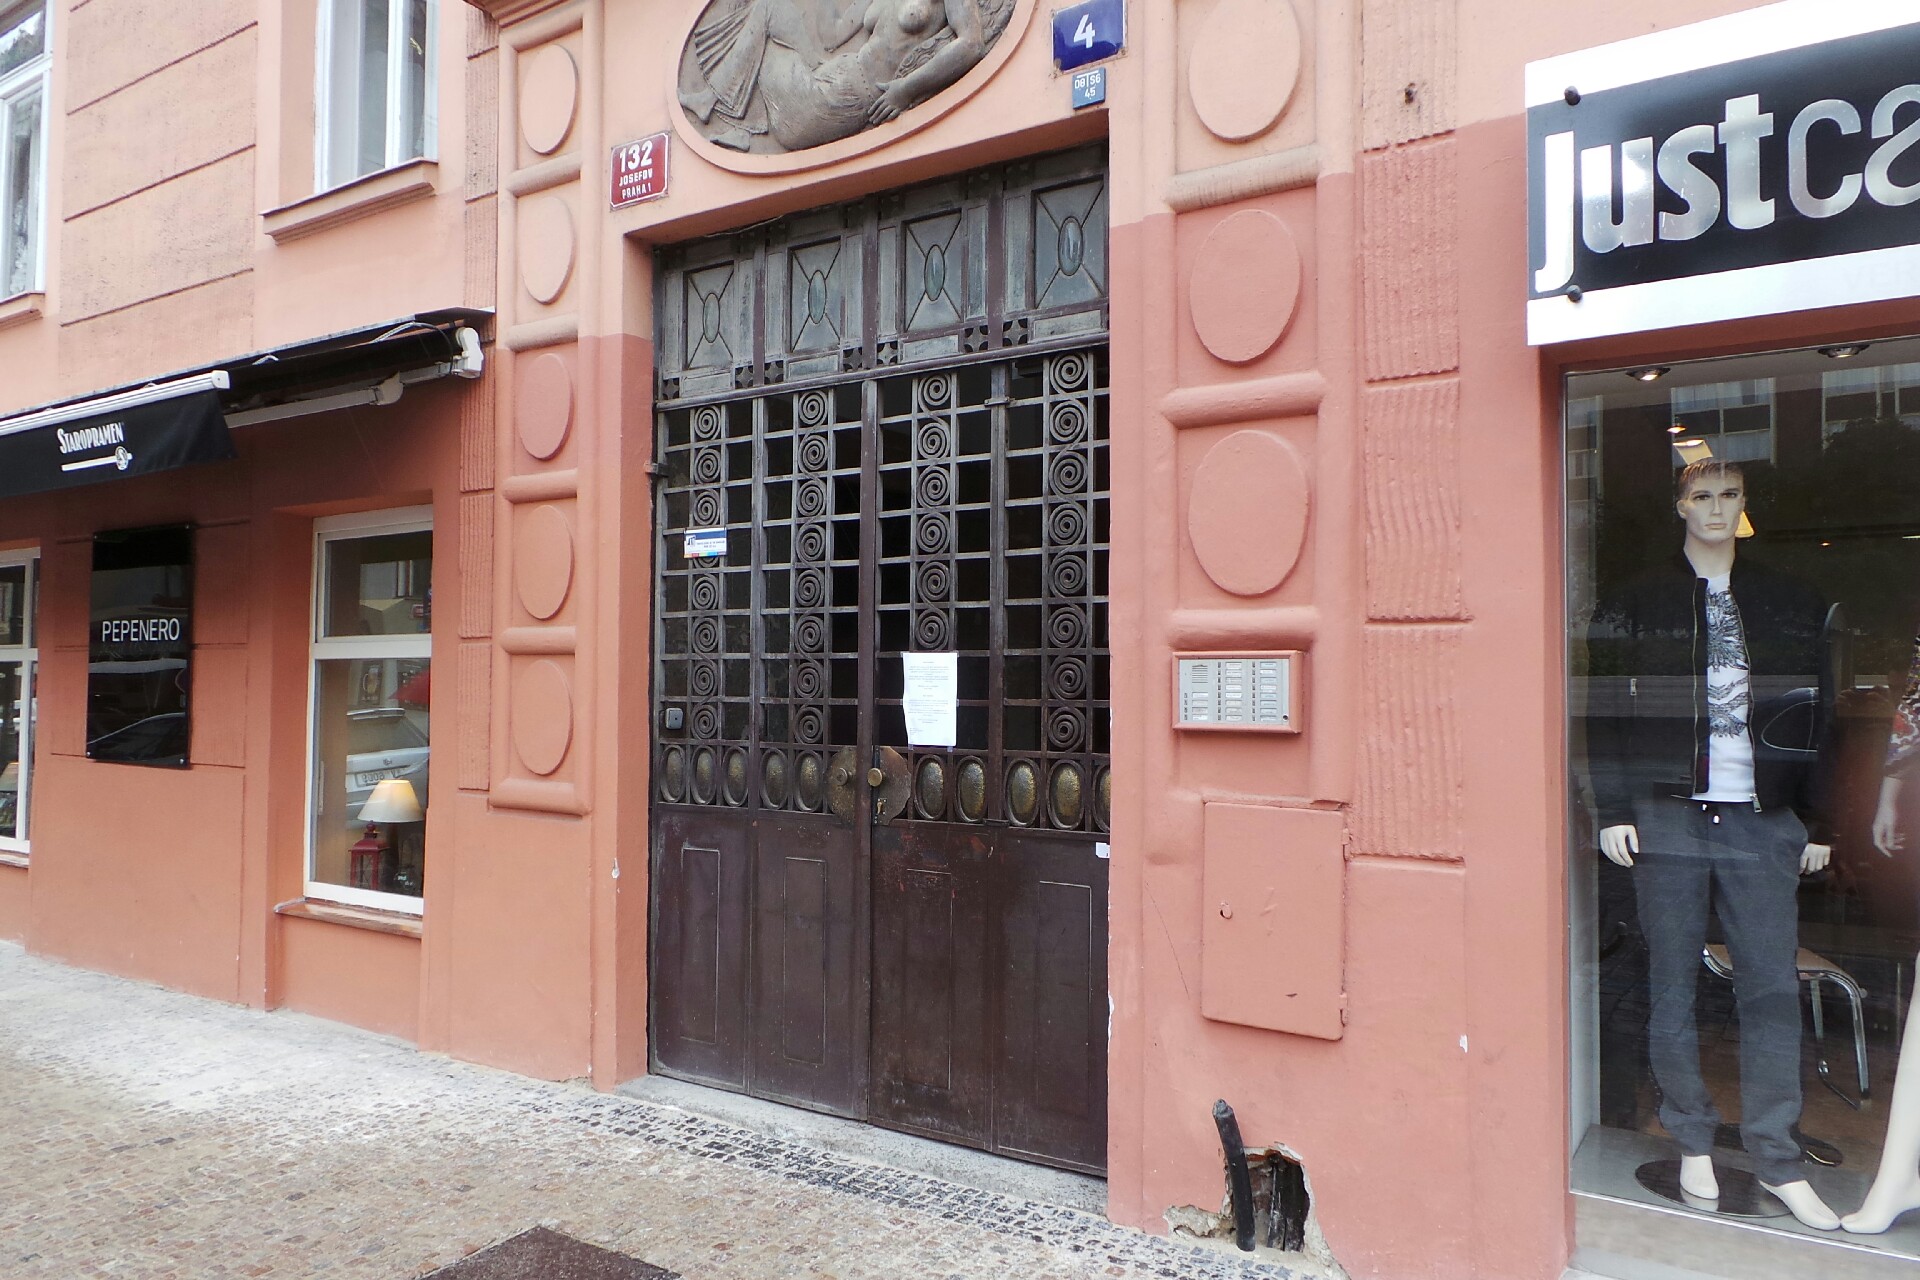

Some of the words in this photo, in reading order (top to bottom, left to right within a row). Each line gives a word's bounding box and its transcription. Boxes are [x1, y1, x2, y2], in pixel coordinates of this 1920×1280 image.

[1073, 13, 1096, 49] 4
[1084, 86, 1096, 98] 45
[619, 140, 653, 173] 132
[618, 168, 653, 187] JOSEFOV
[621, 184, 646, 200] PRAHA
[647, 182, 652, 192] 1
[57, 422, 124, 454] STAROPRAMEN
[102, 617, 180, 642] PEPENERO
